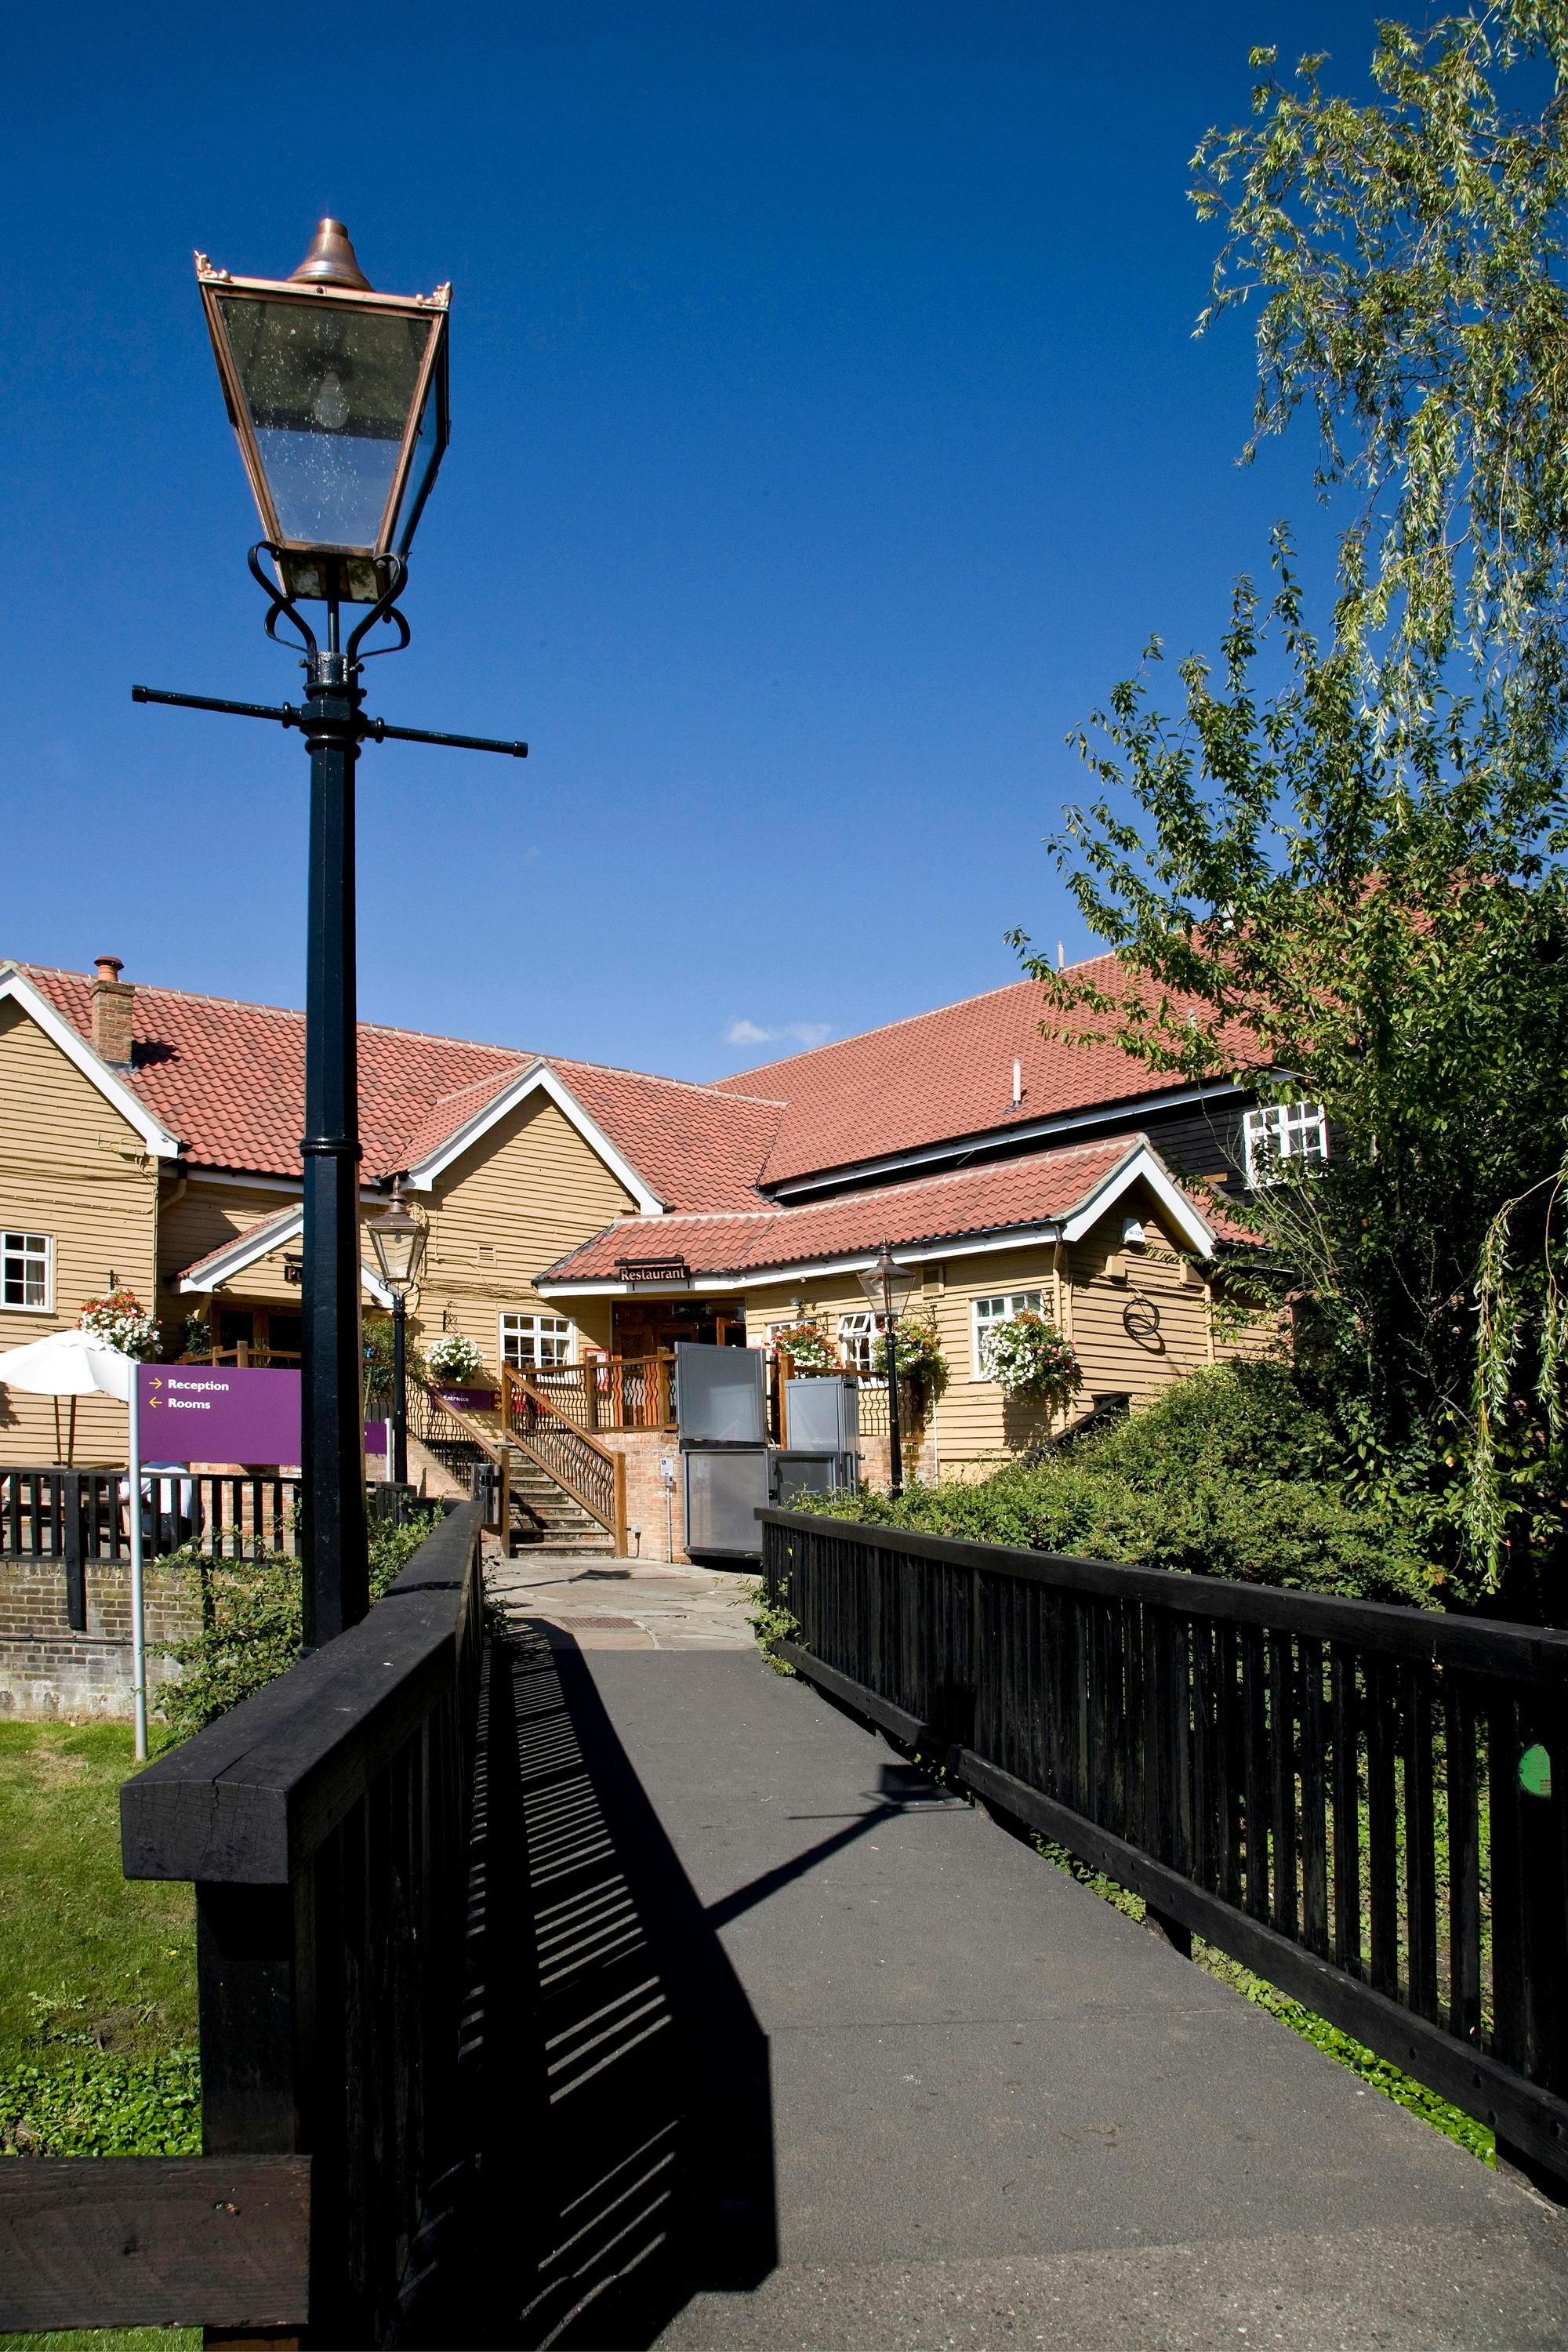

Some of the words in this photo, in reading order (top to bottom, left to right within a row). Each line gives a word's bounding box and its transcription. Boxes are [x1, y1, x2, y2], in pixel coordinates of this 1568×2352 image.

[620, 1267, 686, 1281] Restaurant
[168, 1379, 230, 1392] Reception
[168, 1398, 211, 1410] Rooms
